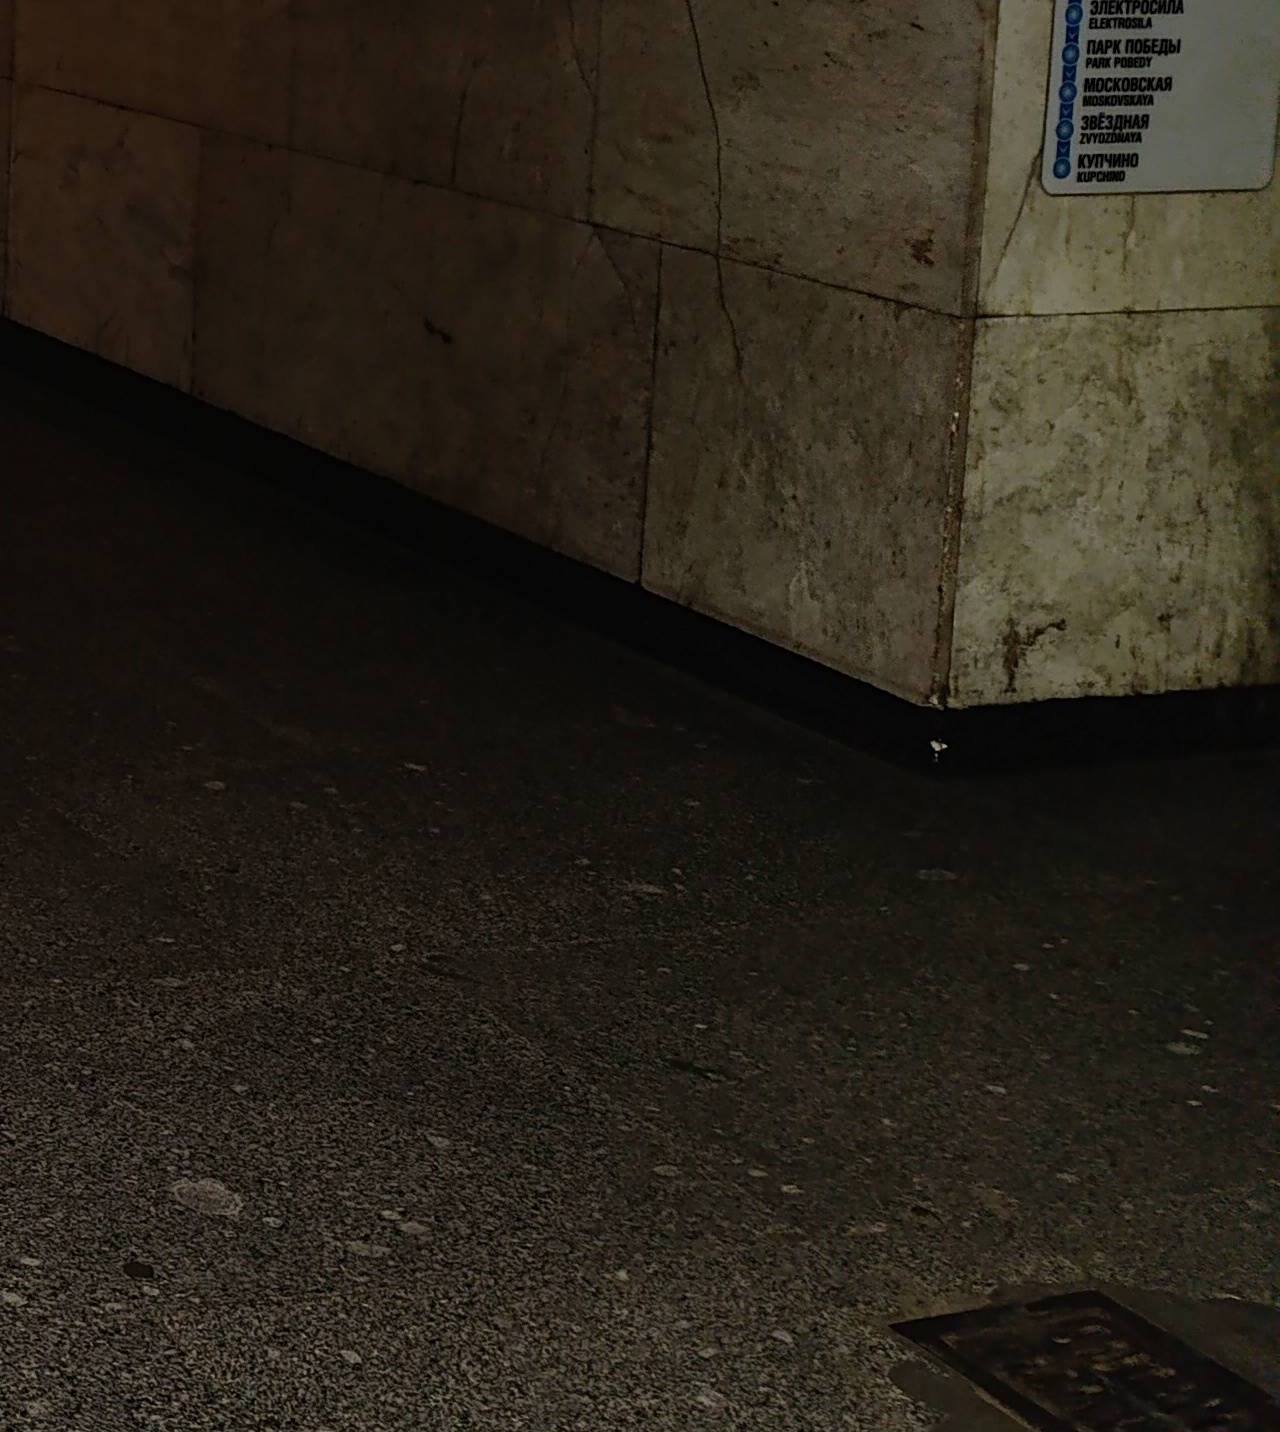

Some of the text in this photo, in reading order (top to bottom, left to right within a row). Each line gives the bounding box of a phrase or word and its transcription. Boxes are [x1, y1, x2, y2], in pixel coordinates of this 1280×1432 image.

[1089, 0, 1185, 15] ЭЛЕКТРОСИЛА
[1088, 17, 1153, 29] ELEKTROSILA
[1086, 38, 1181, 55] ПАРК ПОБЕДЫ
[1085, 56, 1153, 69] PARK POBEDY
[1083, 76, 1173, 92] МОСКОВСКАЯ
[1080, 112, 1150, 131] ЗВЁЗДНАЯ
[1077, 153, 1139, 169] КУПЧИНО
[1076, 170, 1126, 182] KUPCHINO
